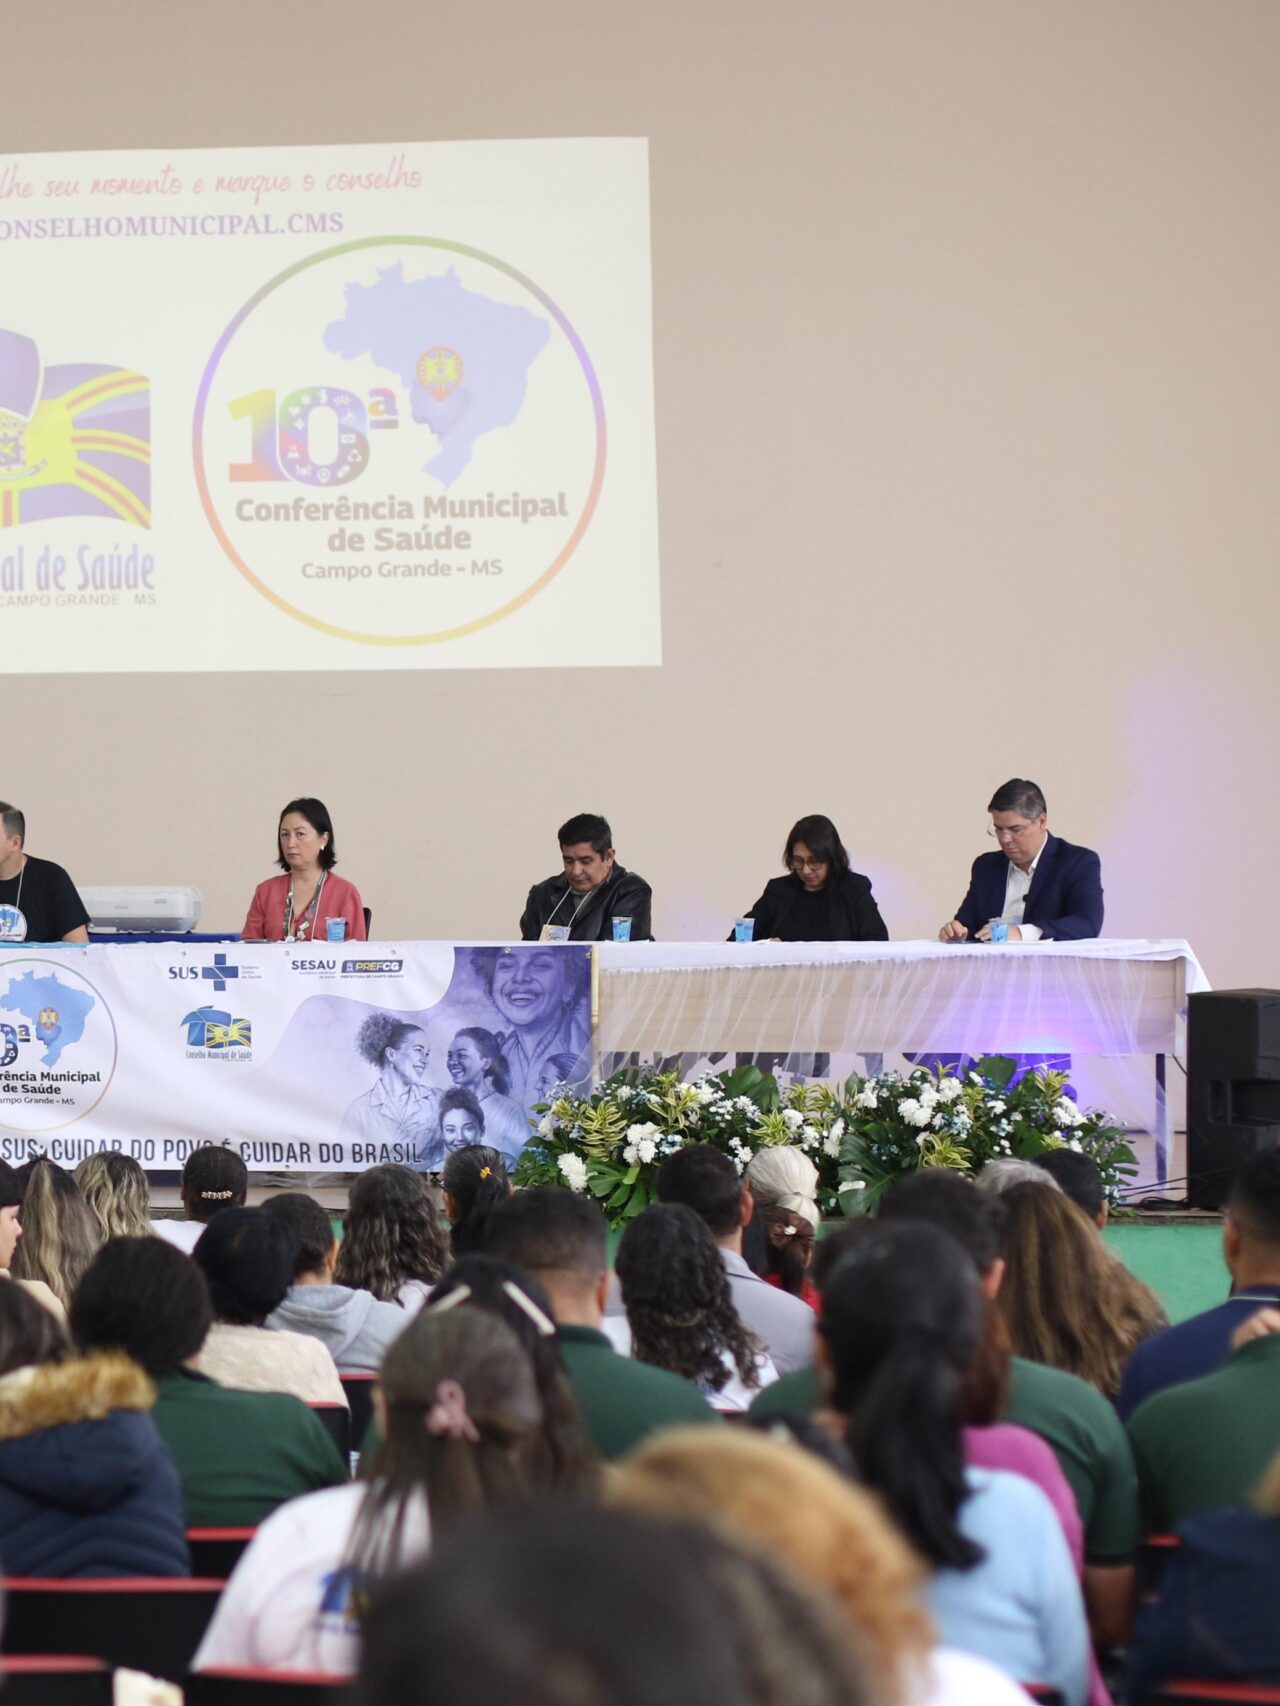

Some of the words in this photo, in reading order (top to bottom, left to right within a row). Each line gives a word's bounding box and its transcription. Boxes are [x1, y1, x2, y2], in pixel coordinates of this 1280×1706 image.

[44, 179, 80, 198] seu
[90, 163, 183, 196] momento
[192, 178, 205, 194] e
[215, 173, 291, 206] marque
[302, 174, 316, 192] o
[326, 153, 423, 191] conselho
[235, 494, 415, 522] Conferência
[423, 491, 568, 524] Municipal
[327, 527, 365, 552] de
[374, 524, 472, 551] Saúde
[36, 545, 67, 592] de
[77, 542, 155, 592] Saúde
[301, 562, 373, 582] Campo
[378, 559, 452, 579] Grande
[471, 559, 504, 577] MS
[54, 593, 121, 607] GRANDE
[134, 592, 157, 606] MS
[168, 966, 199, 980] SUS
[291, 960, 336, 970] SESAU
[355, 961, 400, 971] PREFCG
[40, 1070, 101, 1084] Municipal
[2, 1083, 18, 1093] de
[22, 1083, 62, 1094] Saúde
[24, 1096, 55, 1105] Grande
[131, 1139, 156, 1161] DO
[240, 1141, 312, 1163] CUIDAR
[320, 1142, 344, 1163] DO
[352, 1142, 423, 1164] BRASIL
